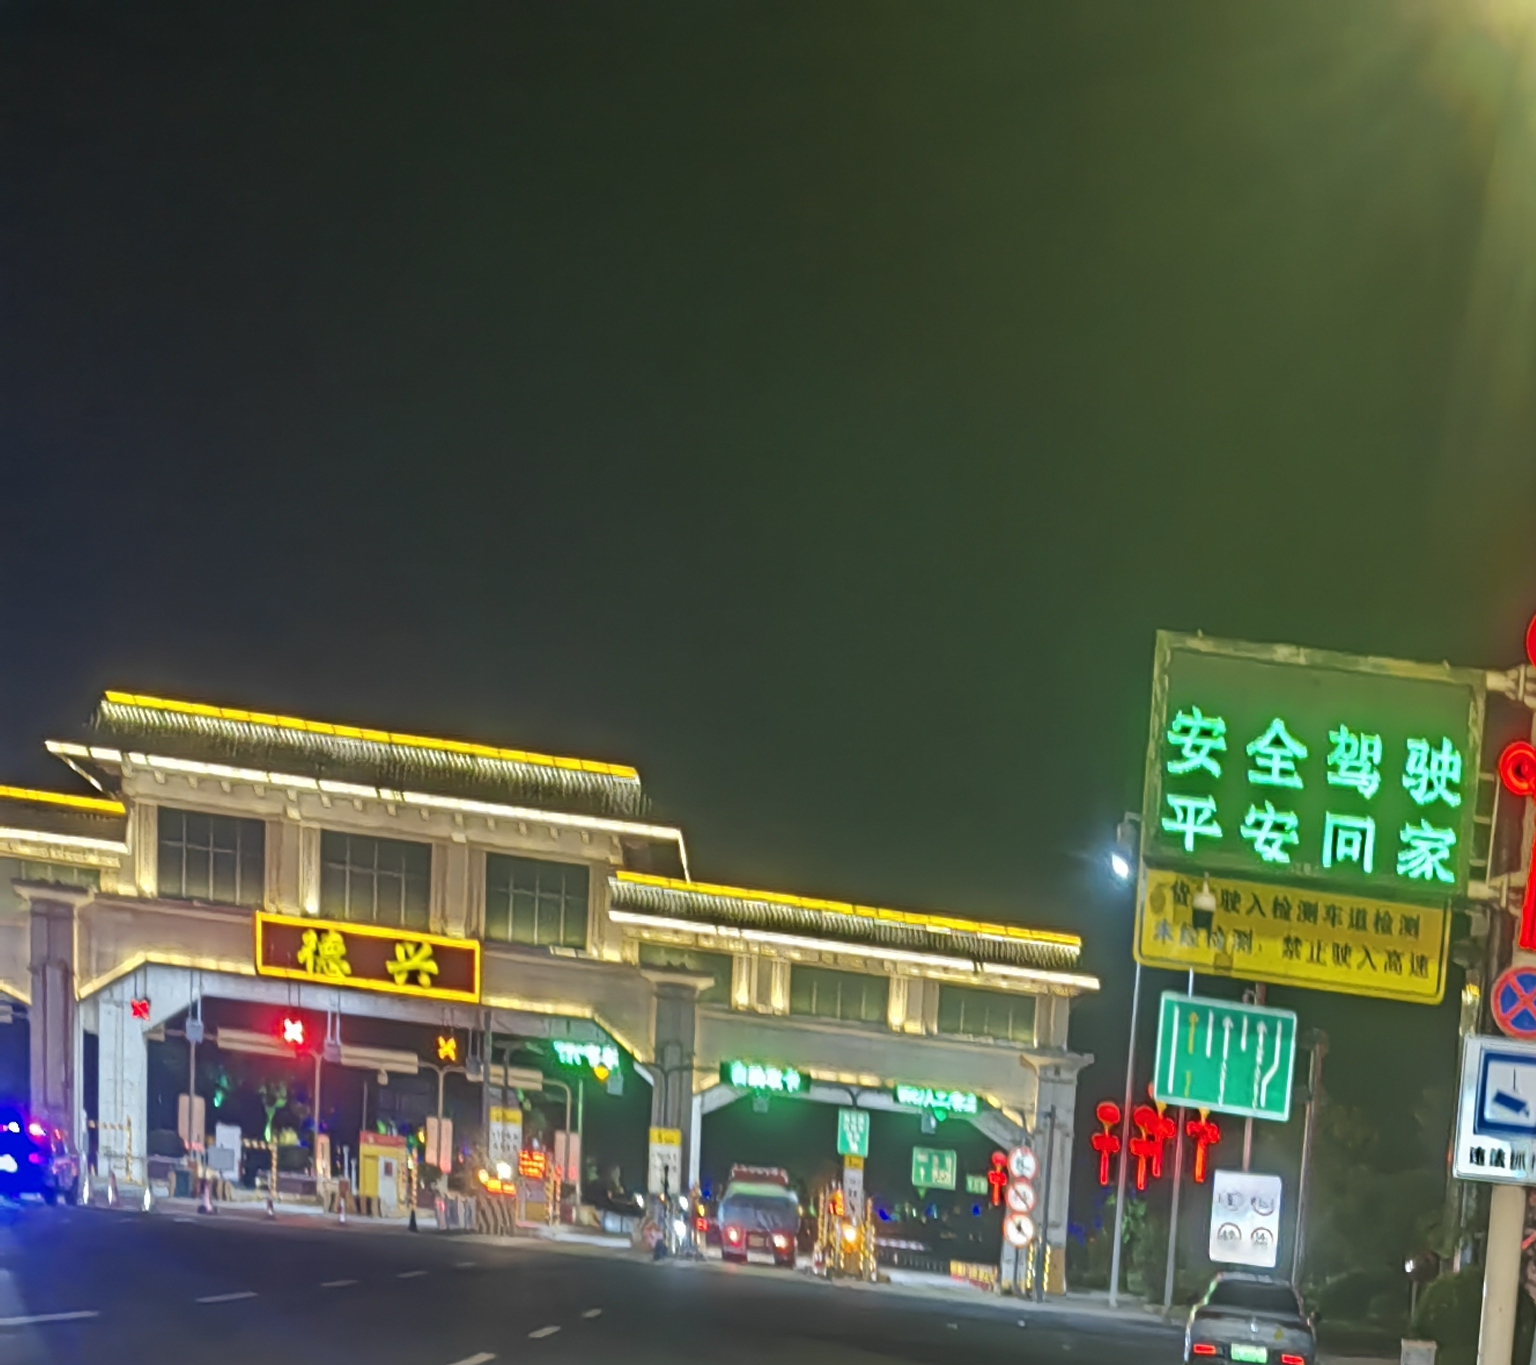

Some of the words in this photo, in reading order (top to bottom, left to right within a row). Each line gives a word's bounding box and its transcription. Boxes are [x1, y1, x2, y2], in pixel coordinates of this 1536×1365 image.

[1166, 705, 1463, 808] 安全驾驶
[1161, 793, 1458, 884] 平安回家
[297, 928, 439, 988] 德兴
